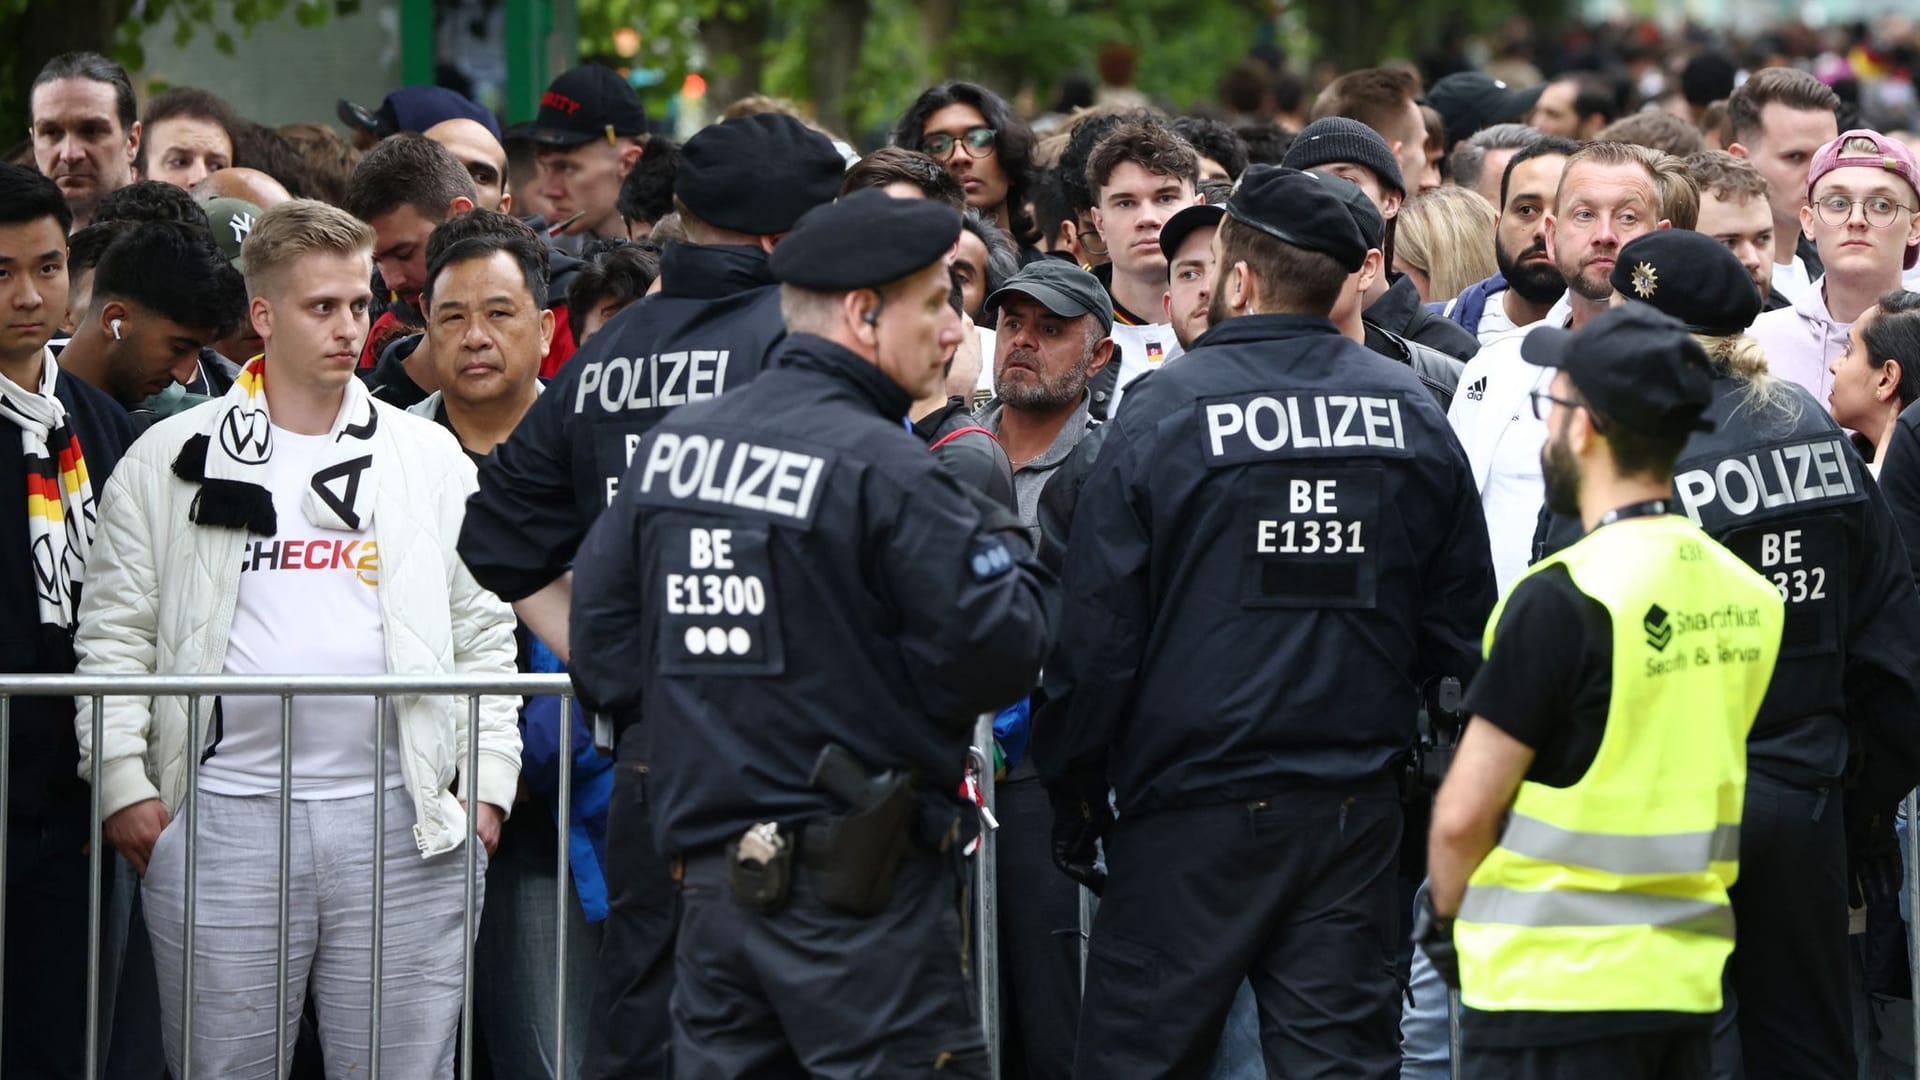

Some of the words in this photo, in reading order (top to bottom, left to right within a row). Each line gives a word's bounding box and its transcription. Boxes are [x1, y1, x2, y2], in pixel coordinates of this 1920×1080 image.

[229, 212, 256, 243] NY
[574, 350, 730, 413] POLIZEI
[1206, 396, 1405, 456] POLIZEI
[641, 433, 825, 519] POLIZEI
[1674, 440, 1855, 528] POLIZEI
[1290, 479, 1338, 514] BE
[690, 528, 734, 569] BE
[1257, 520, 1365, 553] E1331
[1762, 530, 1802, 567] BE
[241, 540, 379, 571] HECK2
[667, 574, 765, 616] E1300
[1761, 567, 1826, 603] 332
[1695, 646, 1710, 667] &
